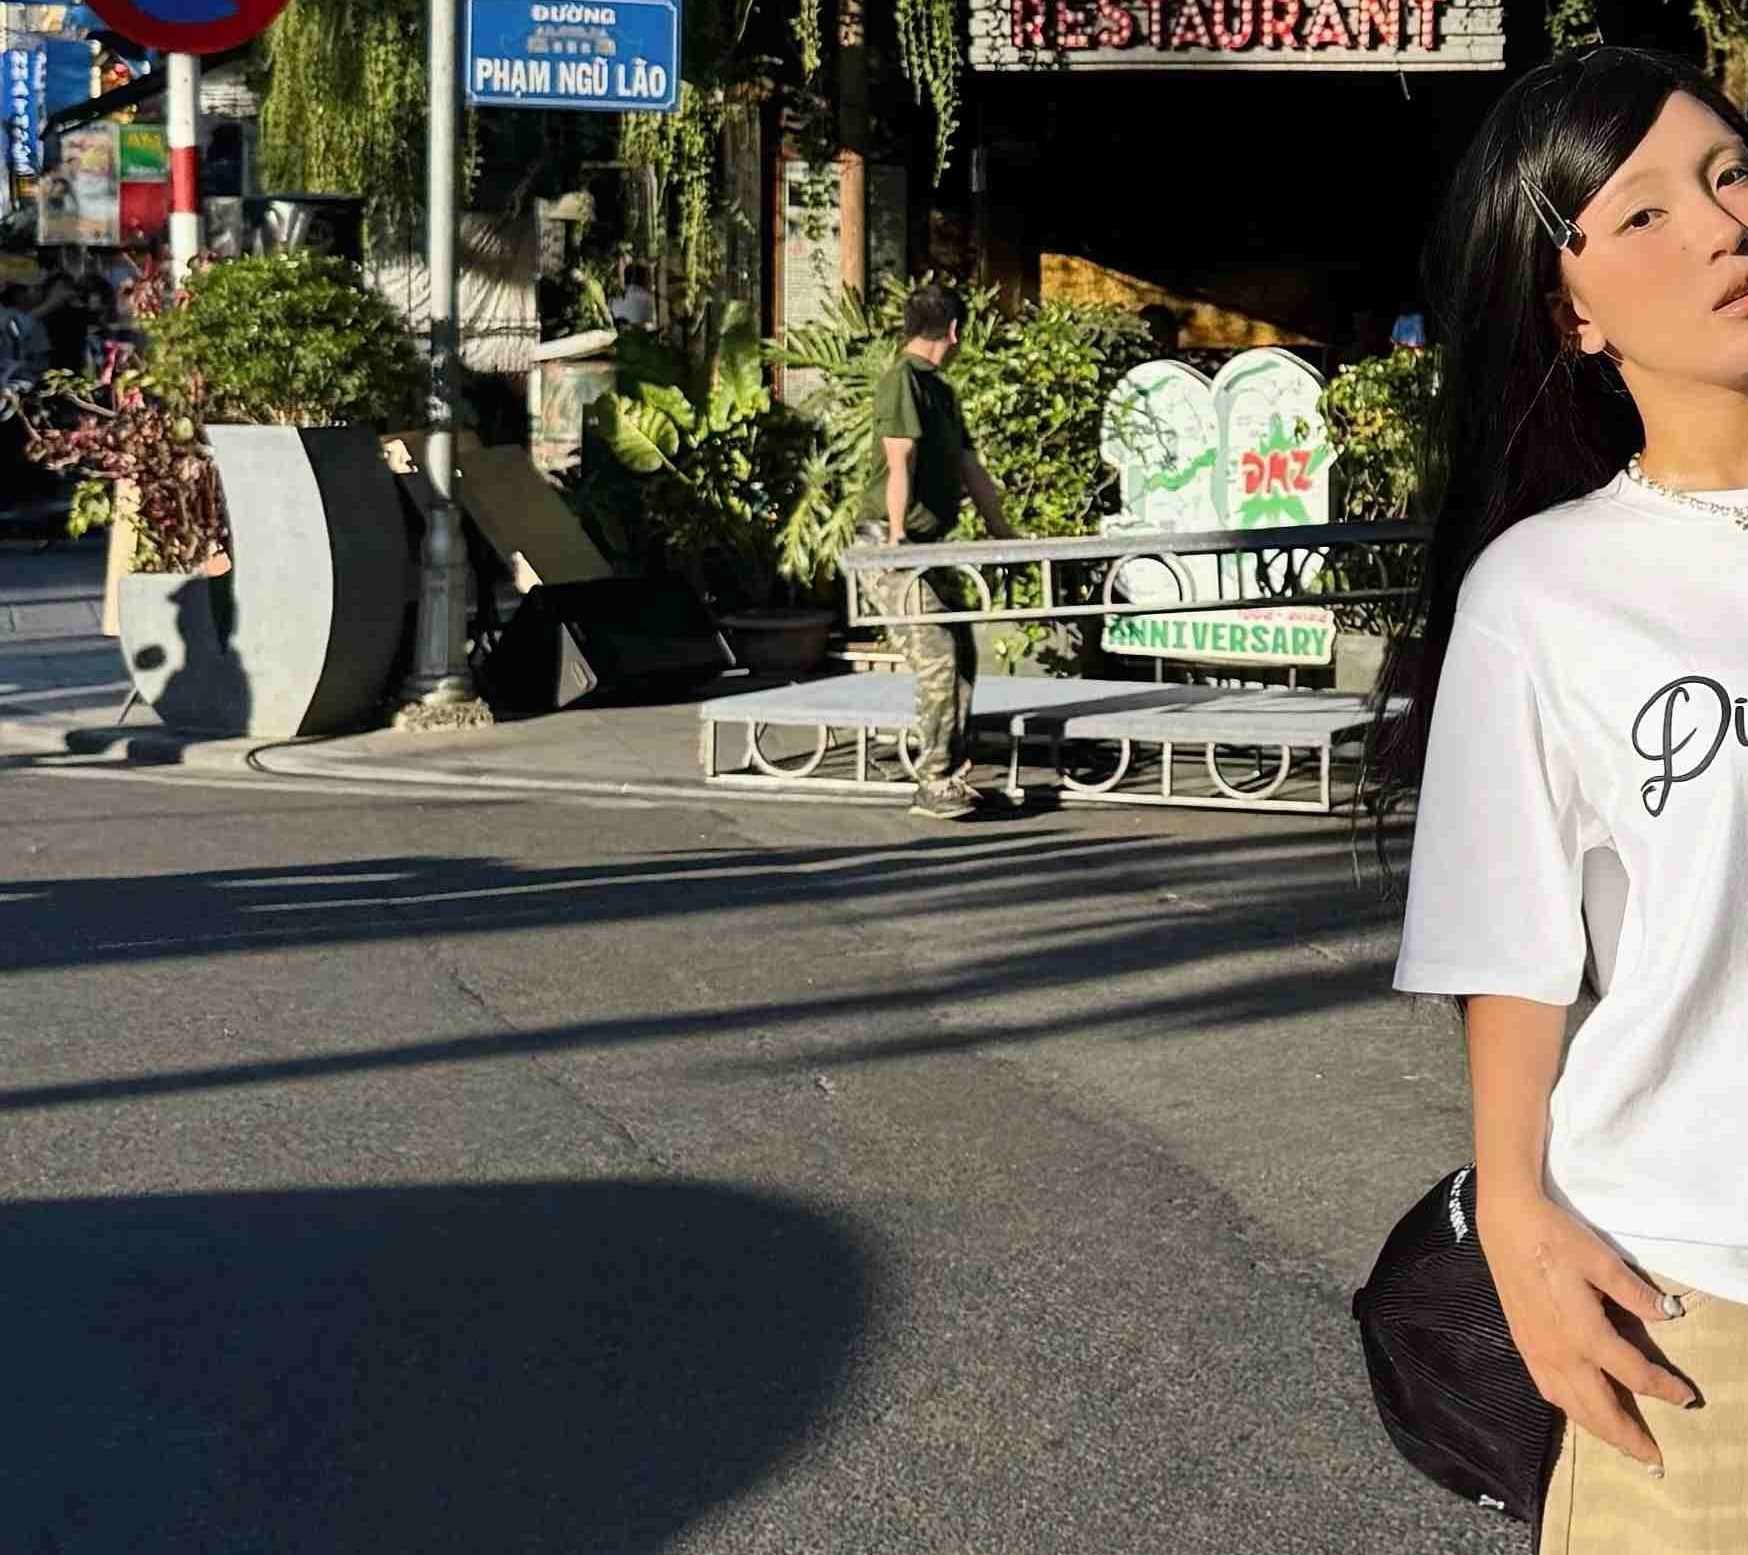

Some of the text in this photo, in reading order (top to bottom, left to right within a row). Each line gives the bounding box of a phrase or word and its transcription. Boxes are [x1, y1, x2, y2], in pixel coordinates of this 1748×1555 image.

[531, 2, 617, 25] ĐƯỜNG
[475, 55, 667, 99] PHẠM NGŨ LÃO
[1241, 448, 1313, 495] DMZ
[1108, 616, 1330, 656] ANNIVERSARY
